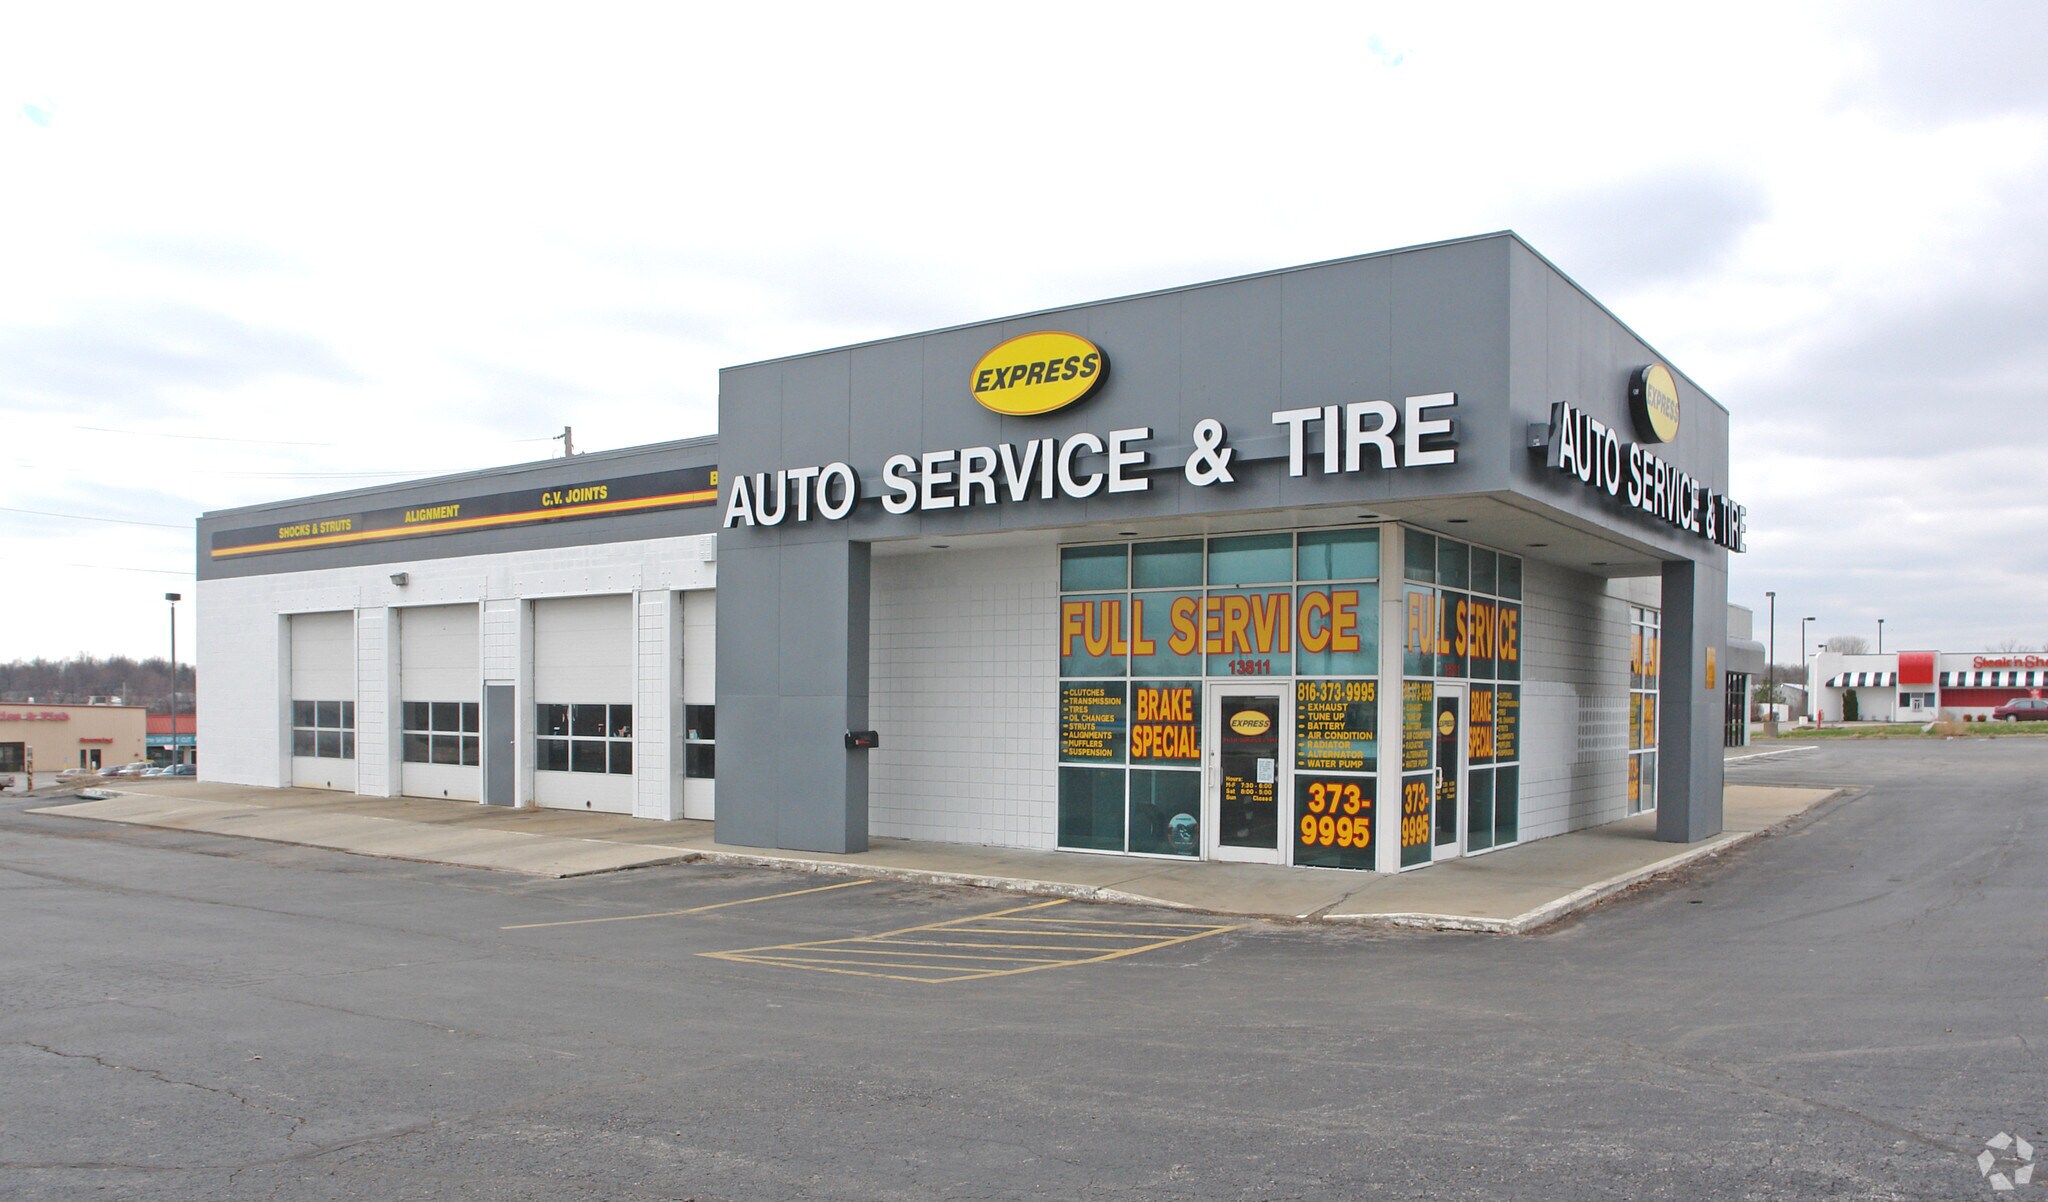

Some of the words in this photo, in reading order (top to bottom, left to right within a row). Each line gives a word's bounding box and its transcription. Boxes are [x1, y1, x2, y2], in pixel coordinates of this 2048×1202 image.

[974, 353, 1098, 393] EXPRESS
[1647, 383, 1679, 423] EXPRESS
[723, 462, 856, 528] AUTO
[881, 427, 1151, 514] SERVICE
[1185, 418, 1234, 486] &
[1272, 392, 1456, 477] TIRE
[1559, 401, 1620, 496] AUTO
[1628, 442, 1700, 533] SERVICE
[1706, 488, 1716, 539] &
[1720, 495, 1746, 553] TIRE
[542, 491, 562, 506] C.V.
[565, 485, 608, 503] JOINTS
[405, 504, 460, 523] ALIGNMENT
[278, 525, 310, 539] SHOCKS
[311, 523, 318, 534] &
[320, 519, 351, 533] STRUTS
[1062, 599, 1155, 657] FULL
[1168, 590, 1360, 656] SERVICE
[1408, 591, 1450, 655] FULL
[1455, 599, 1517, 661] SERVCE
[1228, 660, 1271, 675] 13811
[1069, 697, 1121, 705] TRANSMISSION
[1298, 682, 1375, 701] 816-373-9995
[1137, 688, 1193, 722] BRAKE
[1308, 703, 1348, 711] EXHAUST
[1069, 714, 1079, 722] OIL
[1081, 714, 1115, 722] CHANGES
[1307, 722, 1345, 730] BATTERY
[1068, 740, 1103, 748] MUFFLERS
[1069, 731, 1112, 740] ALIGNMENTS
[1131, 724, 1200, 758] SPECIAL
[1307, 741, 1351, 749] RADIATOR
[1324, 732, 1373, 740] CONDITION
[1068, 748, 1112, 757] SUSPENSION
[1308, 750, 1363, 759] ALTERNATOR
[1307, 760, 1336, 768] WATER
[1339, 760, 1363, 768] PUMP
[1308, 782, 1371, 815] 373-
[1405, 782, 1430, 815] 373-
[1300, 814, 1370, 848] 9995
[1401, 814, 1429, 848] 9995
